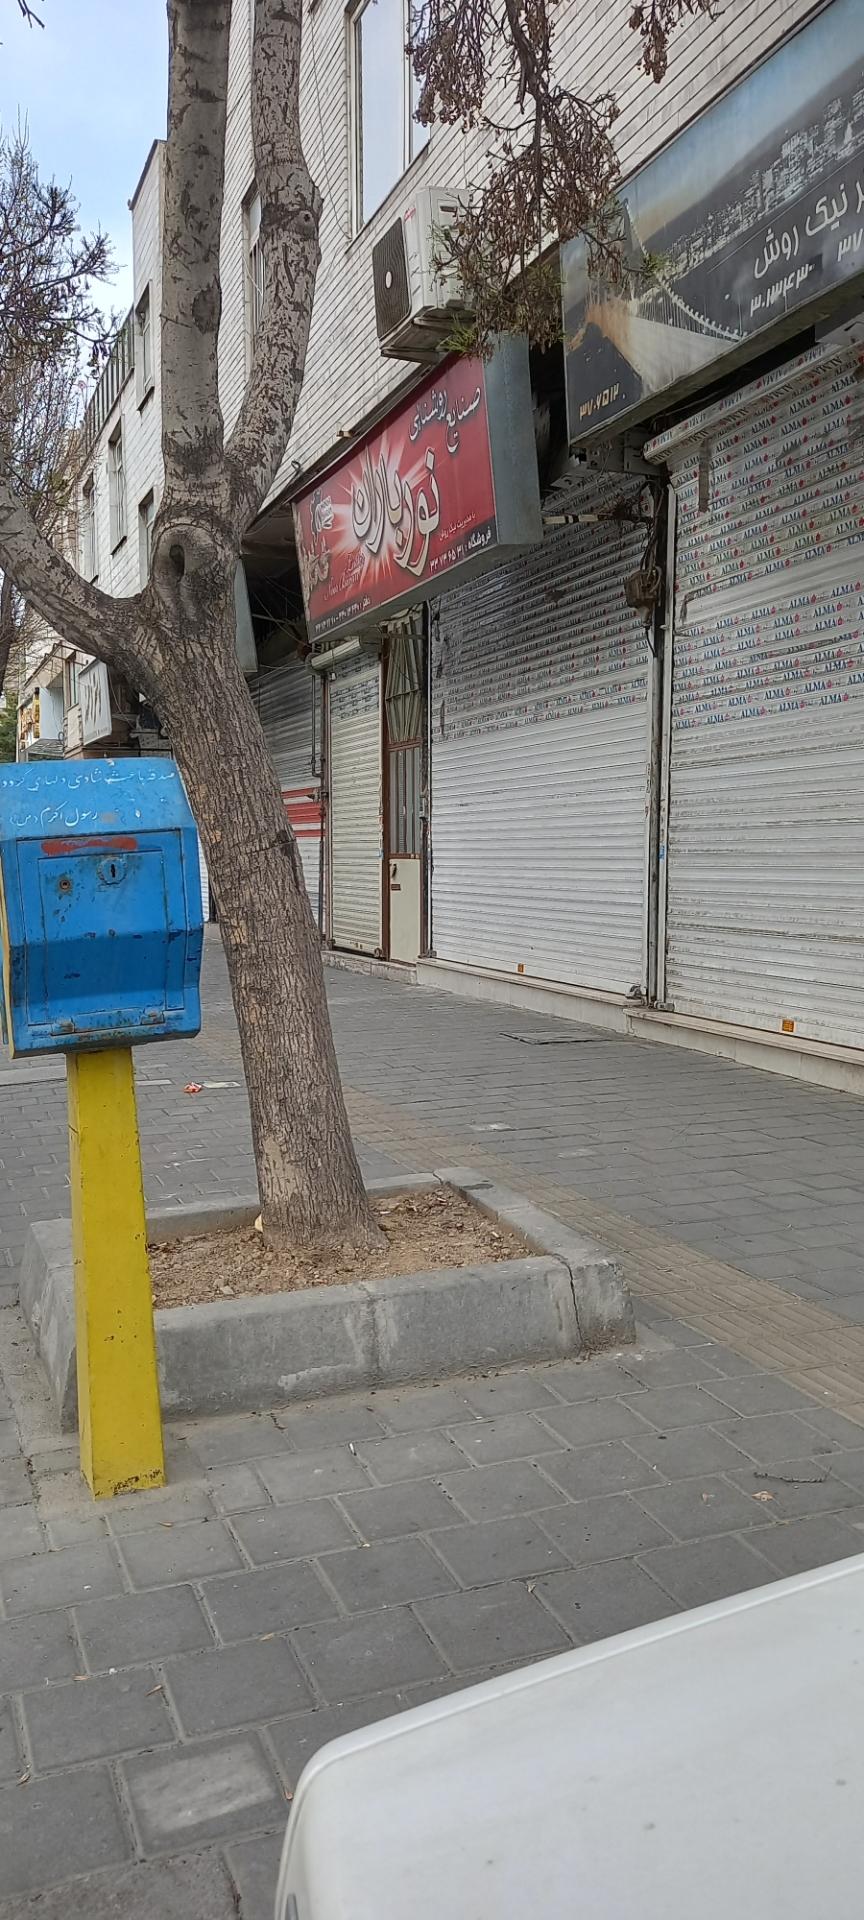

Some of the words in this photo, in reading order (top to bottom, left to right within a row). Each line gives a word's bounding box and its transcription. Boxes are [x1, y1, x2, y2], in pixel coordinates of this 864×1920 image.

[805, 183, 848, 237] نیک
[754, 225, 799, 279] روش
[446, 387, 481, 453] صنایع
[676, 473, 694, 486] ALMA
[744, 438, 762, 456] ALMA
[781, 420, 802, 436] ALMA
[821, 399, 845, 417] ALMA
[716, 439, 735, 454] ALMA
[751, 417, 771, 434] ALMA
[789, 398, 812, 416] ALMA
[744, 455, 763, 472] ALMA
[782, 437, 801, 453] ALMA
[824, 416, 845, 434] ALMA
[713, 497, 730, 511] ALMA
[746, 479, 766, 497] ALMA
[784, 462, 805, 480] ALMA
[827, 442, 849, 459] ALMA
[732, 476, 749, 490] ALMA
[807, 442, 827, 456] ALMA
[741, 497, 761, 513] ALMA
[779, 481, 799, 496] ALMA
[819, 462, 841, 481] ALMA
[352, 445, 403, 554] باران
[394, 447, 440, 577] نور
[688, 535, 704, 548] ALMA
[720, 521, 737, 535] ALMA
[755, 506, 774, 521] ALMA
[793, 490, 814, 506] ALMA
[835, 473, 858, 490] ALMA
[710, 539, 727, 552] ALMA
[743, 524, 761, 540] ALMA
[781, 510, 801, 525] ALMA
[822, 493, 844, 509] ALMA
[684, 560, 700, 575] ALMA
[716, 549, 733, 564] ALMA
[752, 536, 769, 551] ALMA
[787, 521, 808, 538] ALMA
[829, 505, 851, 521] ALMA
[689, 572, 706, 587] ALMA
[722, 561, 740, 576] ALMA
[756, 547, 775, 562] ALMA
[794, 534, 815, 551] ALMA
[836, 518, 858, 536] ALMA
[696, 584, 712, 599] ALMA
[730, 573, 747, 586] ALMA
[764, 559, 785, 575] ALMA
[804, 546, 825, 561] ALMA
[703, 635, 720, 646] ALMA
[736, 625, 755, 639] ALMA
[774, 615, 794, 629] ALMA
[814, 602, 836, 618] ALMA
[716, 617, 734, 630] ALMA
[751, 605, 771, 620] ALMA
[790, 596, 810, 610] ALMA
[830, 583, 855, 598] ALMA
[703, 649, 721, 660] ALMA
[737, 638, 756, 652] ALMA
[775, 628, 795, 641] ALMA
[815, 617, 837, 632] ALMA
[680, 693, 695, 703] ALMA
[712, 686, 728, 697] ALMA
[745, 677, 764, 690] ALMA
[784, 668, 804, 681] ALMA
[825, 658, 848, 673] ALMA
[682, 667, 698, 679] ALMA
[715, 659, 732, 671] ALMA
[703, 676, 720, 687] ALMA
[737, 668, 755, 680] ALMA
[774, 658, 794, 671] ALMA
[814, 649, 835, 663] ALMA
[676, 718, 691, 730] ALMA
[707, 713, 725, 725] ALMA
[741, 706, 761, 719] ALMA
[780, 700, 800, 713] ALMA
[820, 693, 843, 707] ALMA
[695, 702, 713, 714] ALMA
[728, 694, 747, 707] ALMA
[765, 686, 785, 701] ALMA
[804, 679, 826, 693] ALMA
[40, 801, 68, 831] اکرم
[64, 807, 98, 827] رسول
